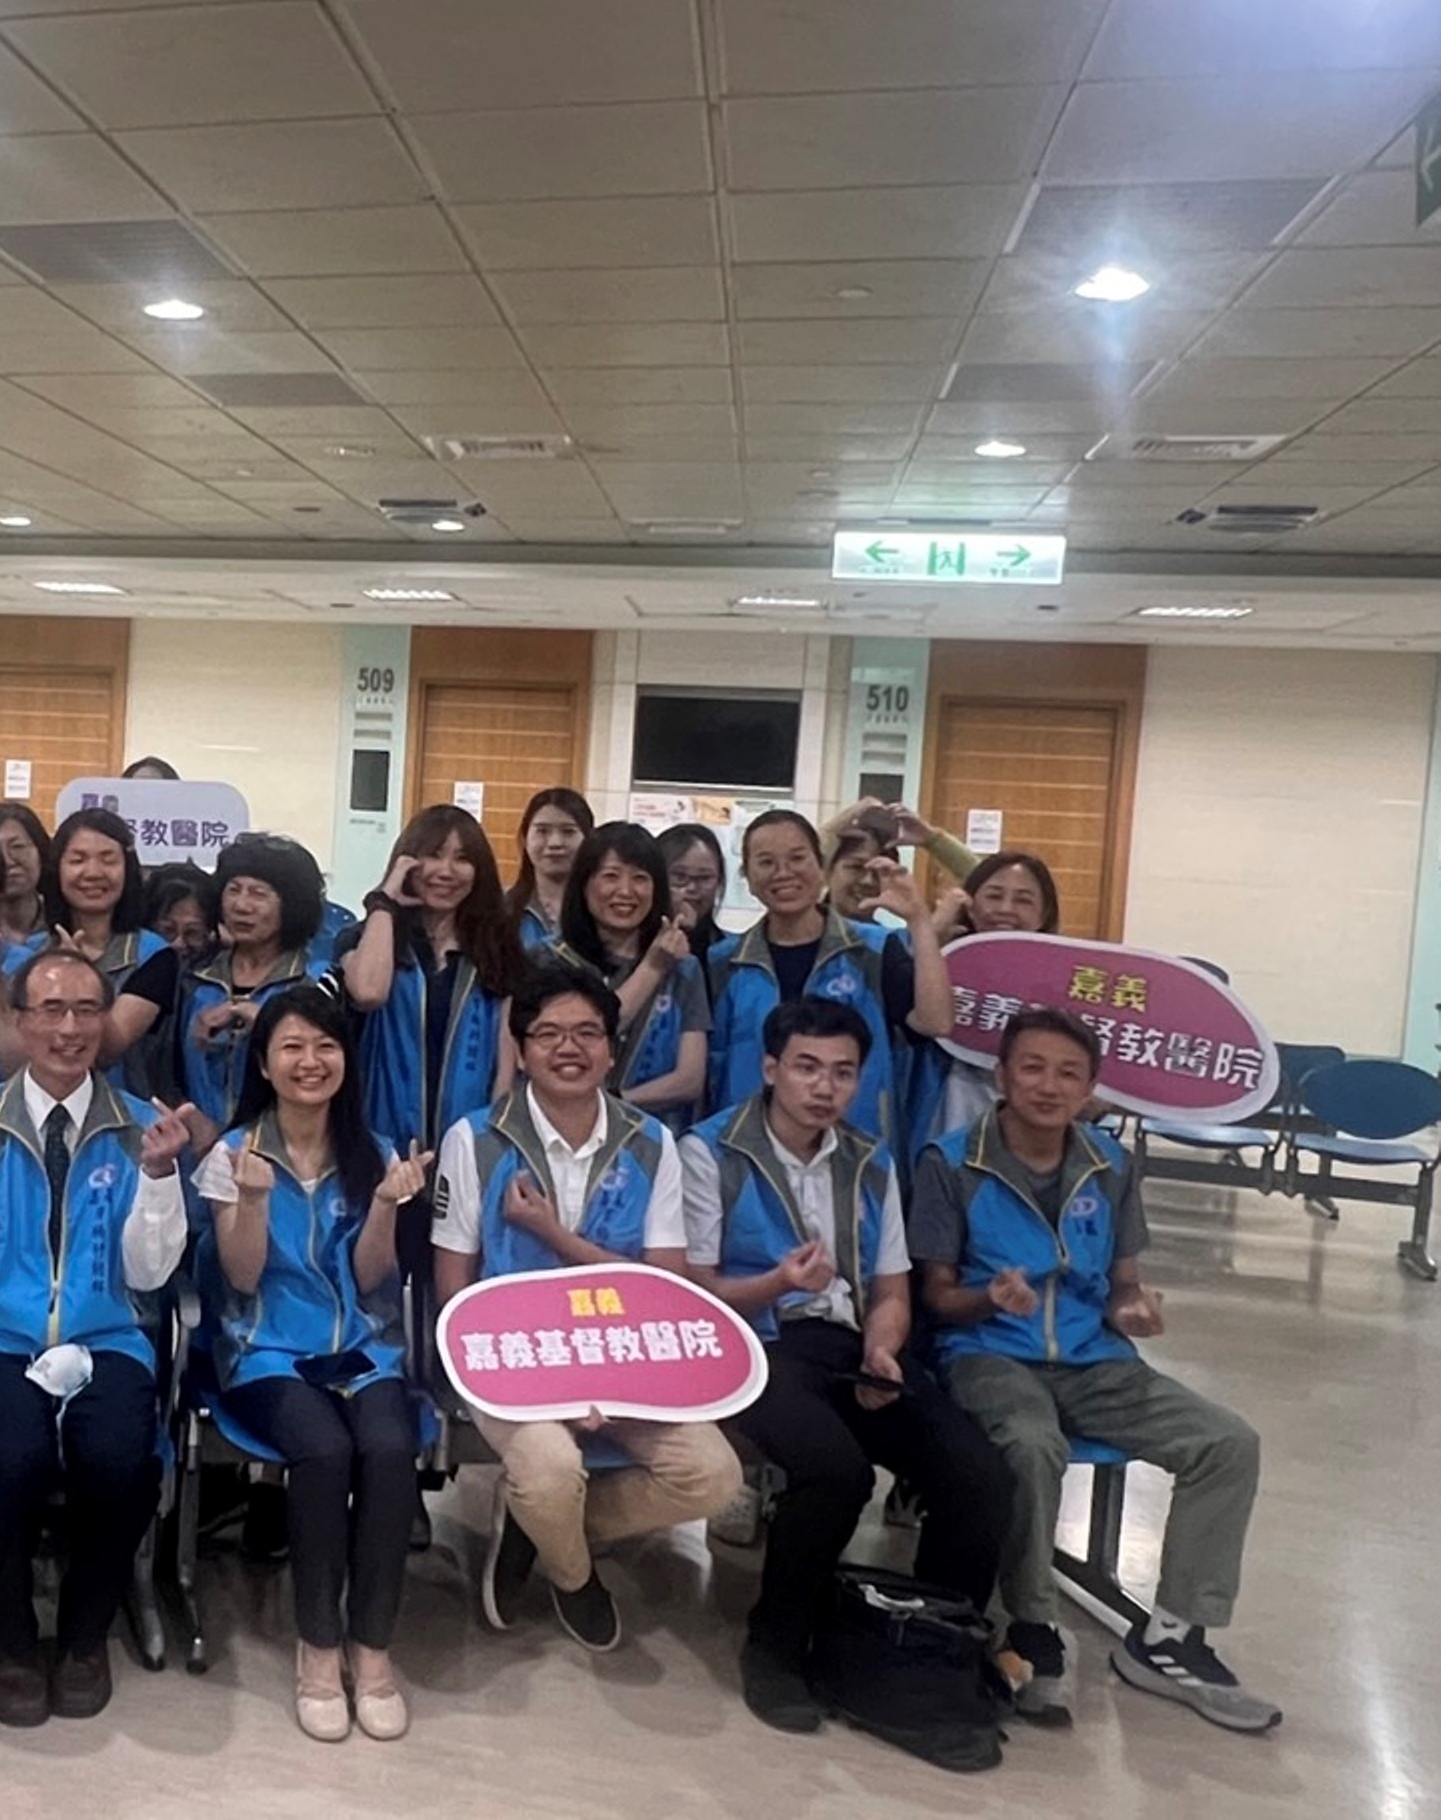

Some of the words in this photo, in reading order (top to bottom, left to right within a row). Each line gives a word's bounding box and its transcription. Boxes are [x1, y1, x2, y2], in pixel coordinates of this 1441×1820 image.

[357, 667, 395, 693] 509
[865, 684, 909, 712] 510
[125, 819, 230, 848] 教醫院
[1068, 964, 1149, 1013] 嘉義
[952, 984, 1265, 1090] 嘉義教醫院
[567, 1287, 625, 1317] 嘉義
[460, 1319, 723, 1371] 嘉義基督教醫院
